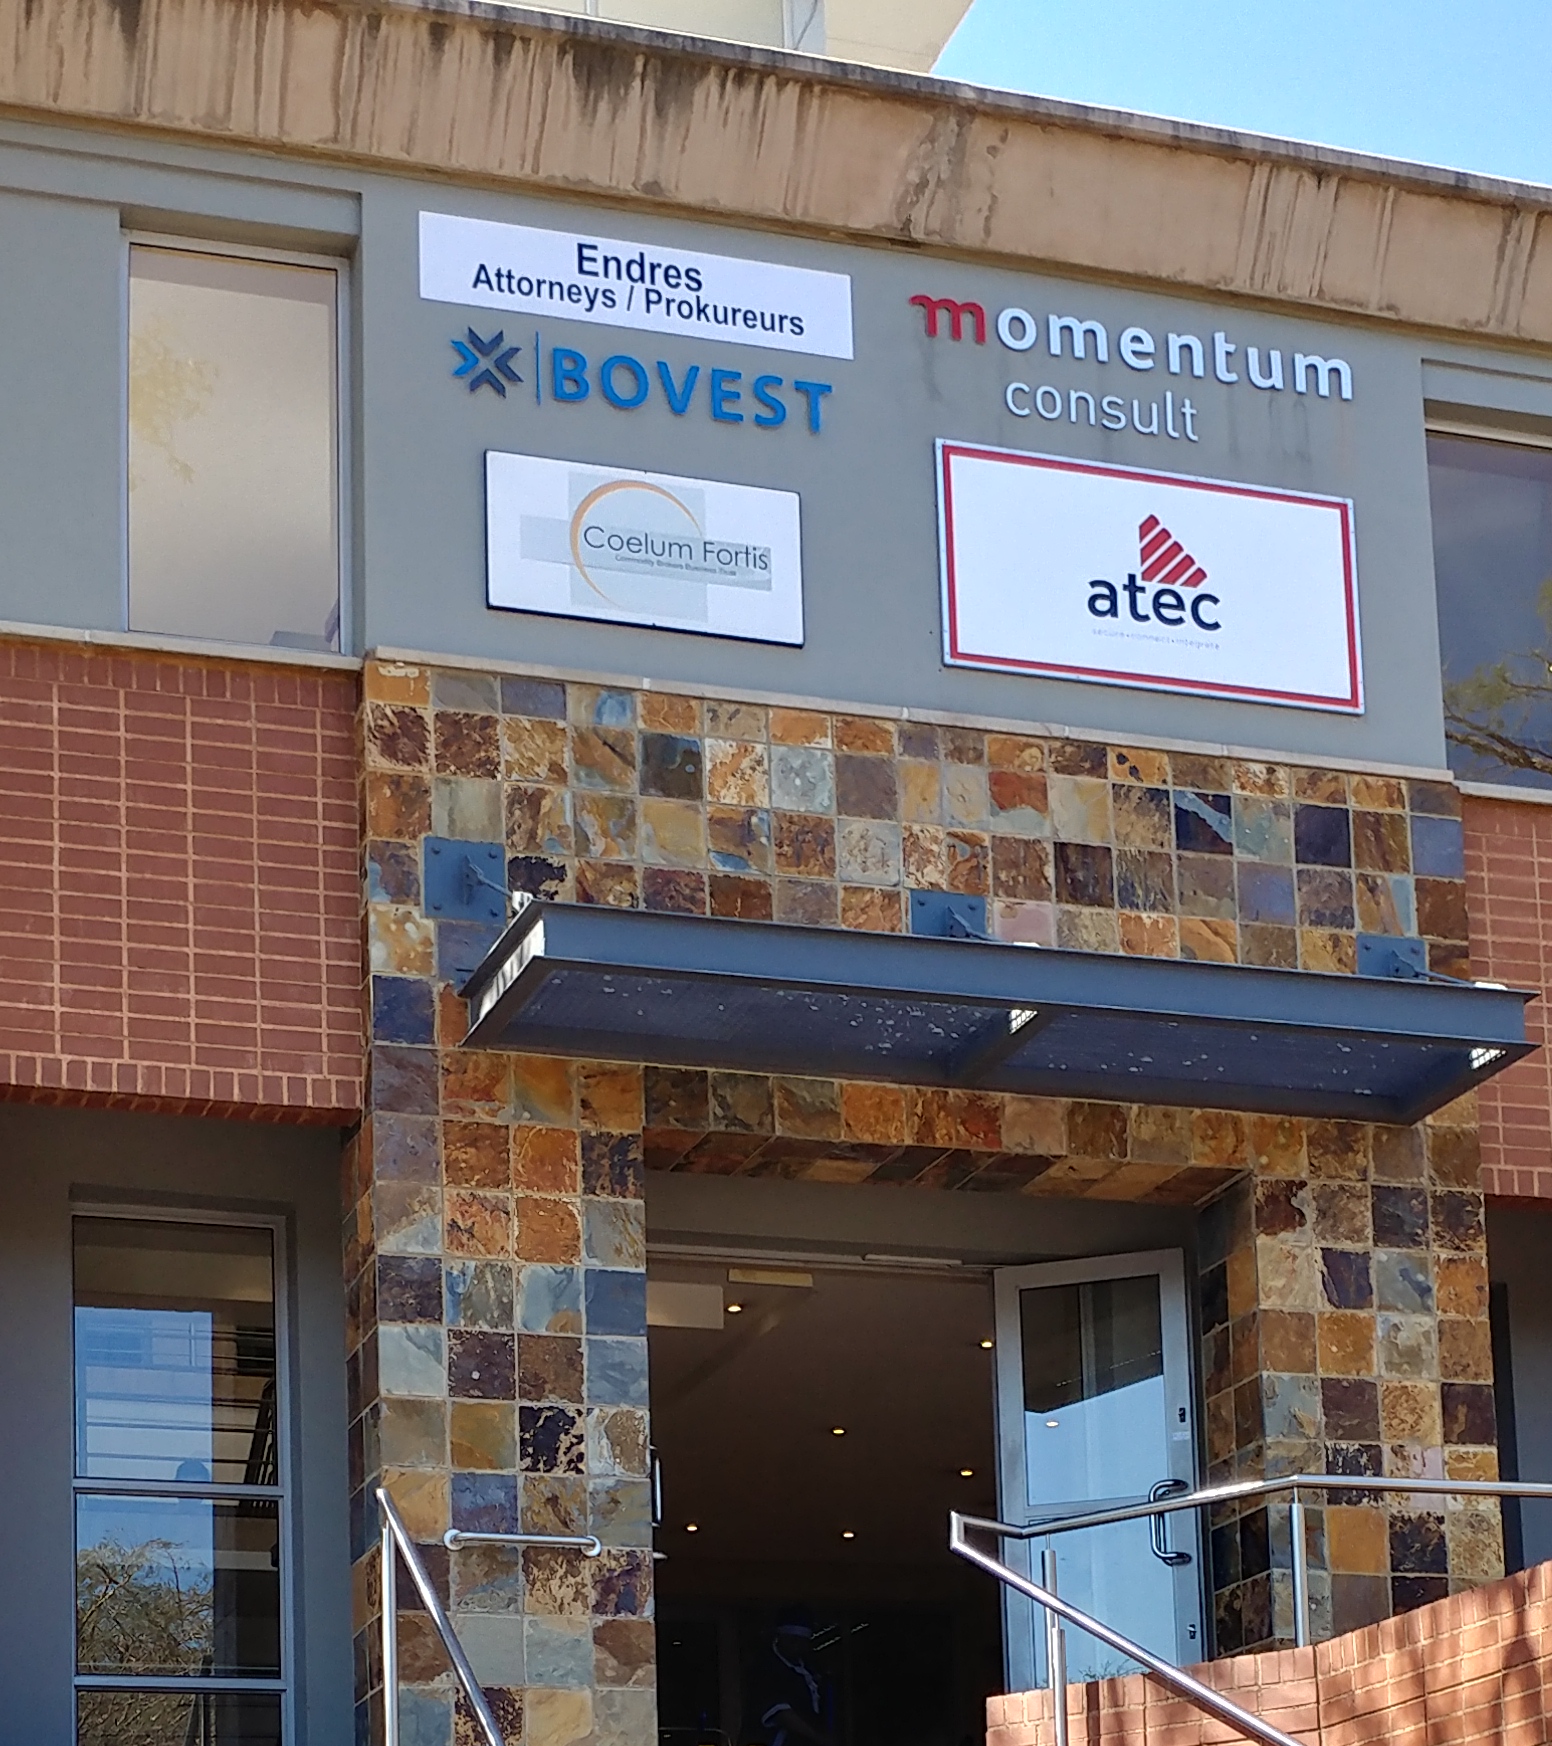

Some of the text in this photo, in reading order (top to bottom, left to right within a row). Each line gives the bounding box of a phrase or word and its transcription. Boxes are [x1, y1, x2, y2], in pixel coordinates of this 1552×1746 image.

[577, 242, 703, 292] Endres
[472, 263, 805, 336] Attorneys / Prokureurs
[909, 294, 1353, 400] momentum
[552, 346, 833, 434] BOVEST
[1006, 381, 1199, 442] consult
[583, 525, 768, 571] Coelum Fortis
[1087, 573, 1222, 631] atec
